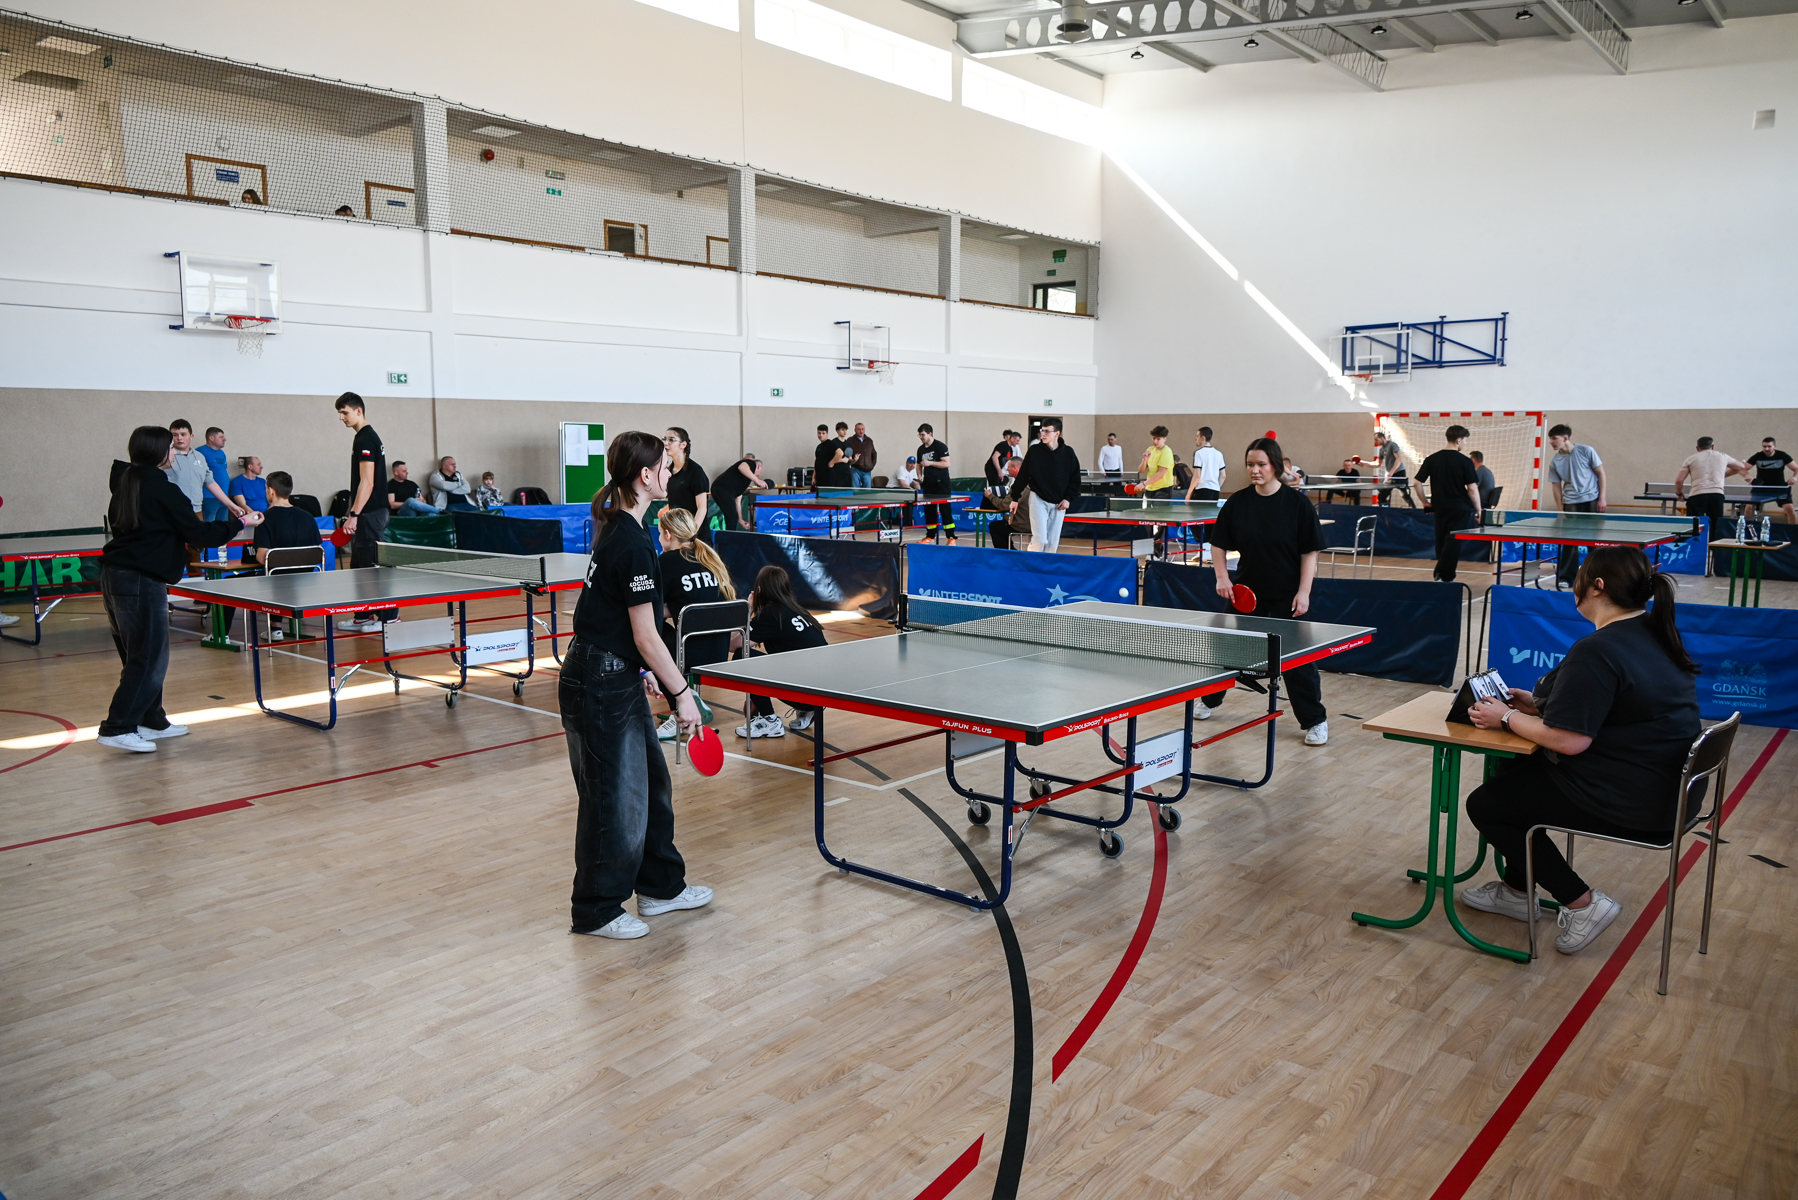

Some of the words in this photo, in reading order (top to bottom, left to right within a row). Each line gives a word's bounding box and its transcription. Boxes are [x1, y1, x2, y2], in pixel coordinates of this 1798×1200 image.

[633, 574, 648, 582] OSP
[632, 583, 655, 592] DRUGA
[482, 641, 520, 651] POLSPORT
[1712, 683, 1767, 696] GDAŃSK
[941, 719, 969, 730] TAJFUN
[971, 725, 993, 734] PLUS
[1145, 751, 1177, 767] POLSPORT
